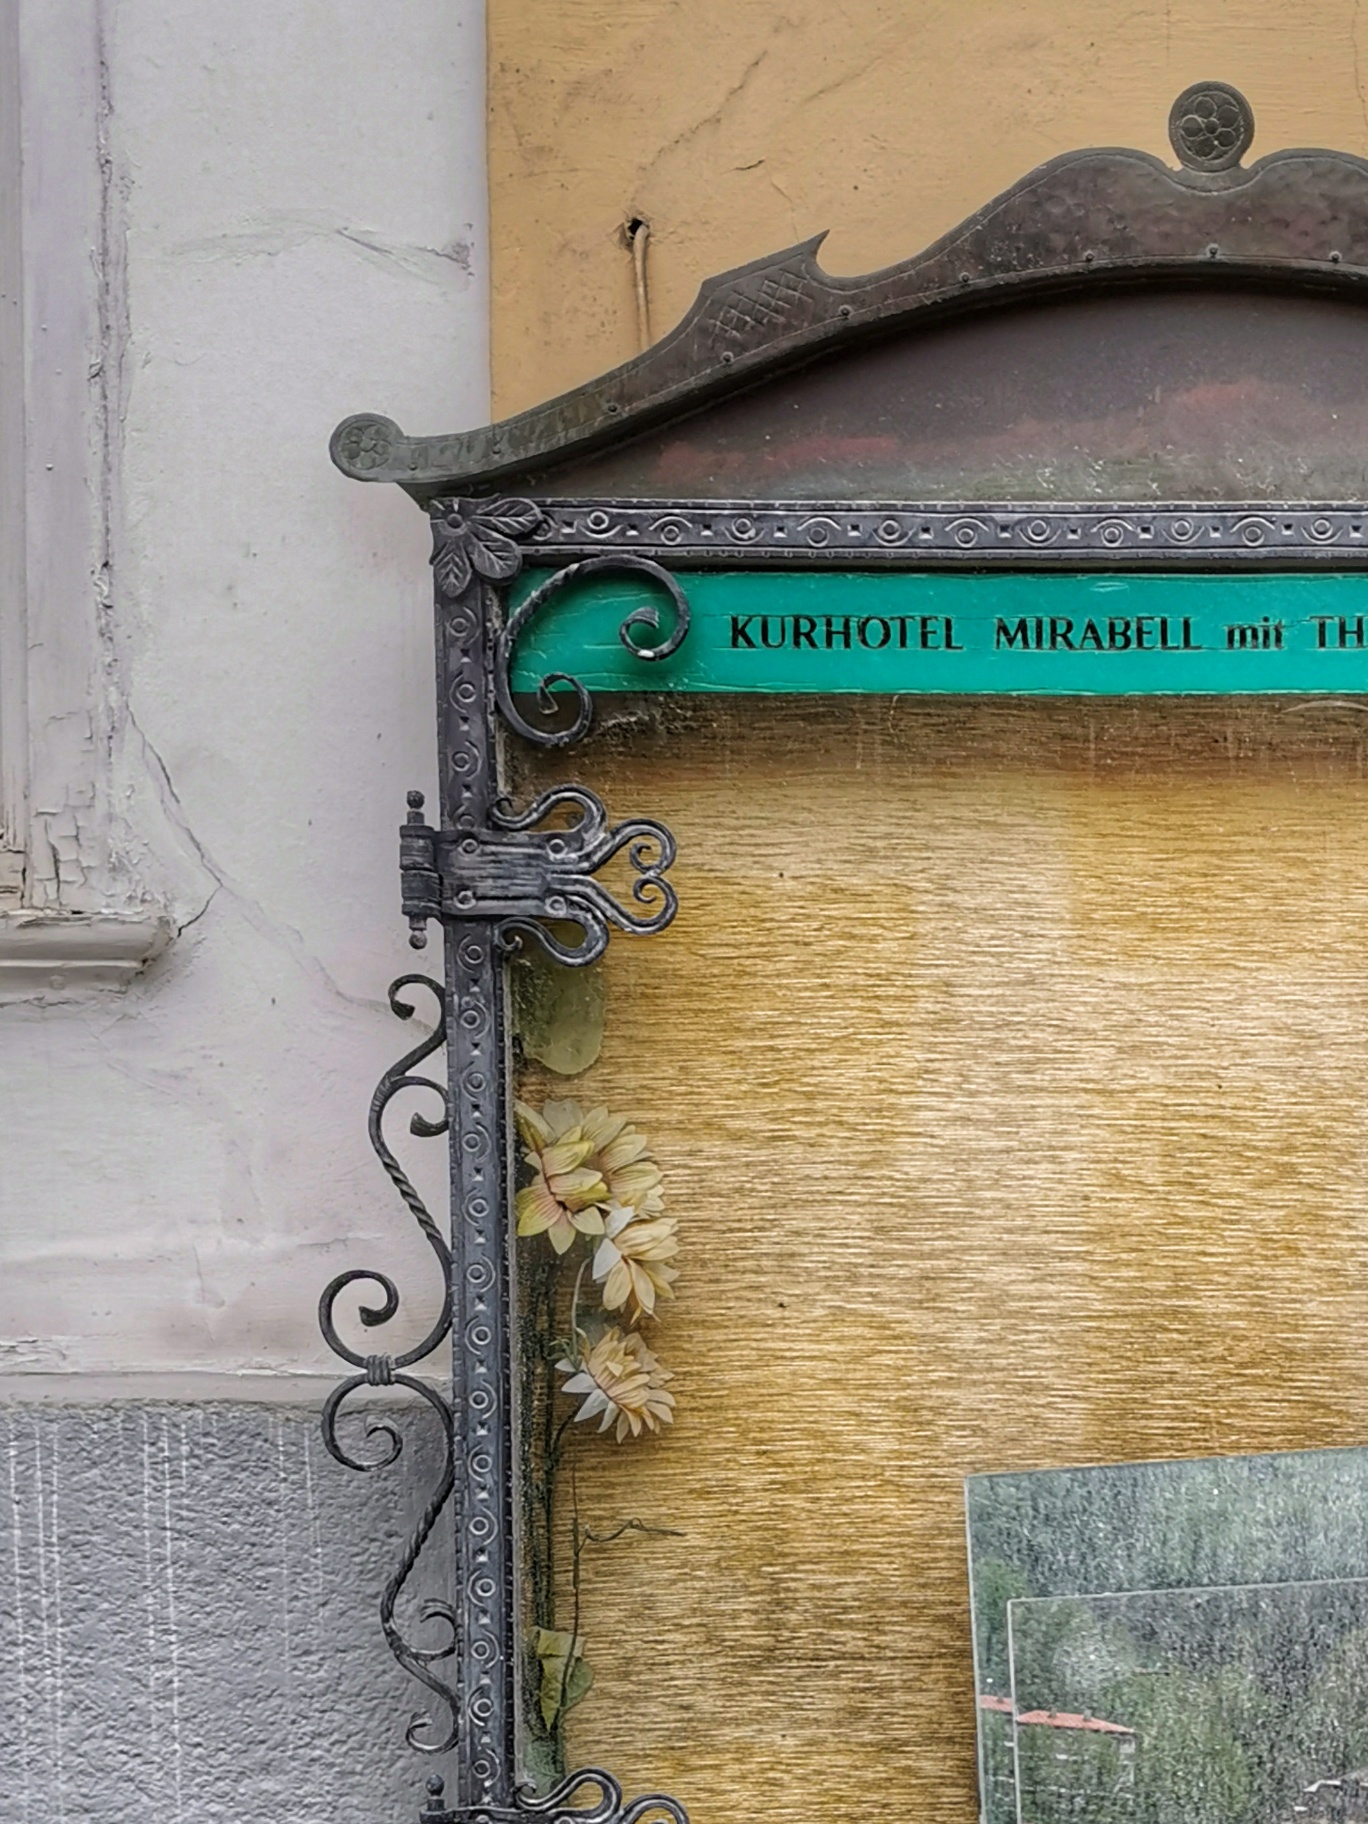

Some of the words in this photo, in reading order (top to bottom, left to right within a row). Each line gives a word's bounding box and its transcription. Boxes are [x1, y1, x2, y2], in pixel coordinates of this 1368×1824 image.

[729, 615, 964, 650] KURHOTEL
[994, 615, 1203, 651] MIRABELL
[1225, 616, 1286, 650] mit
